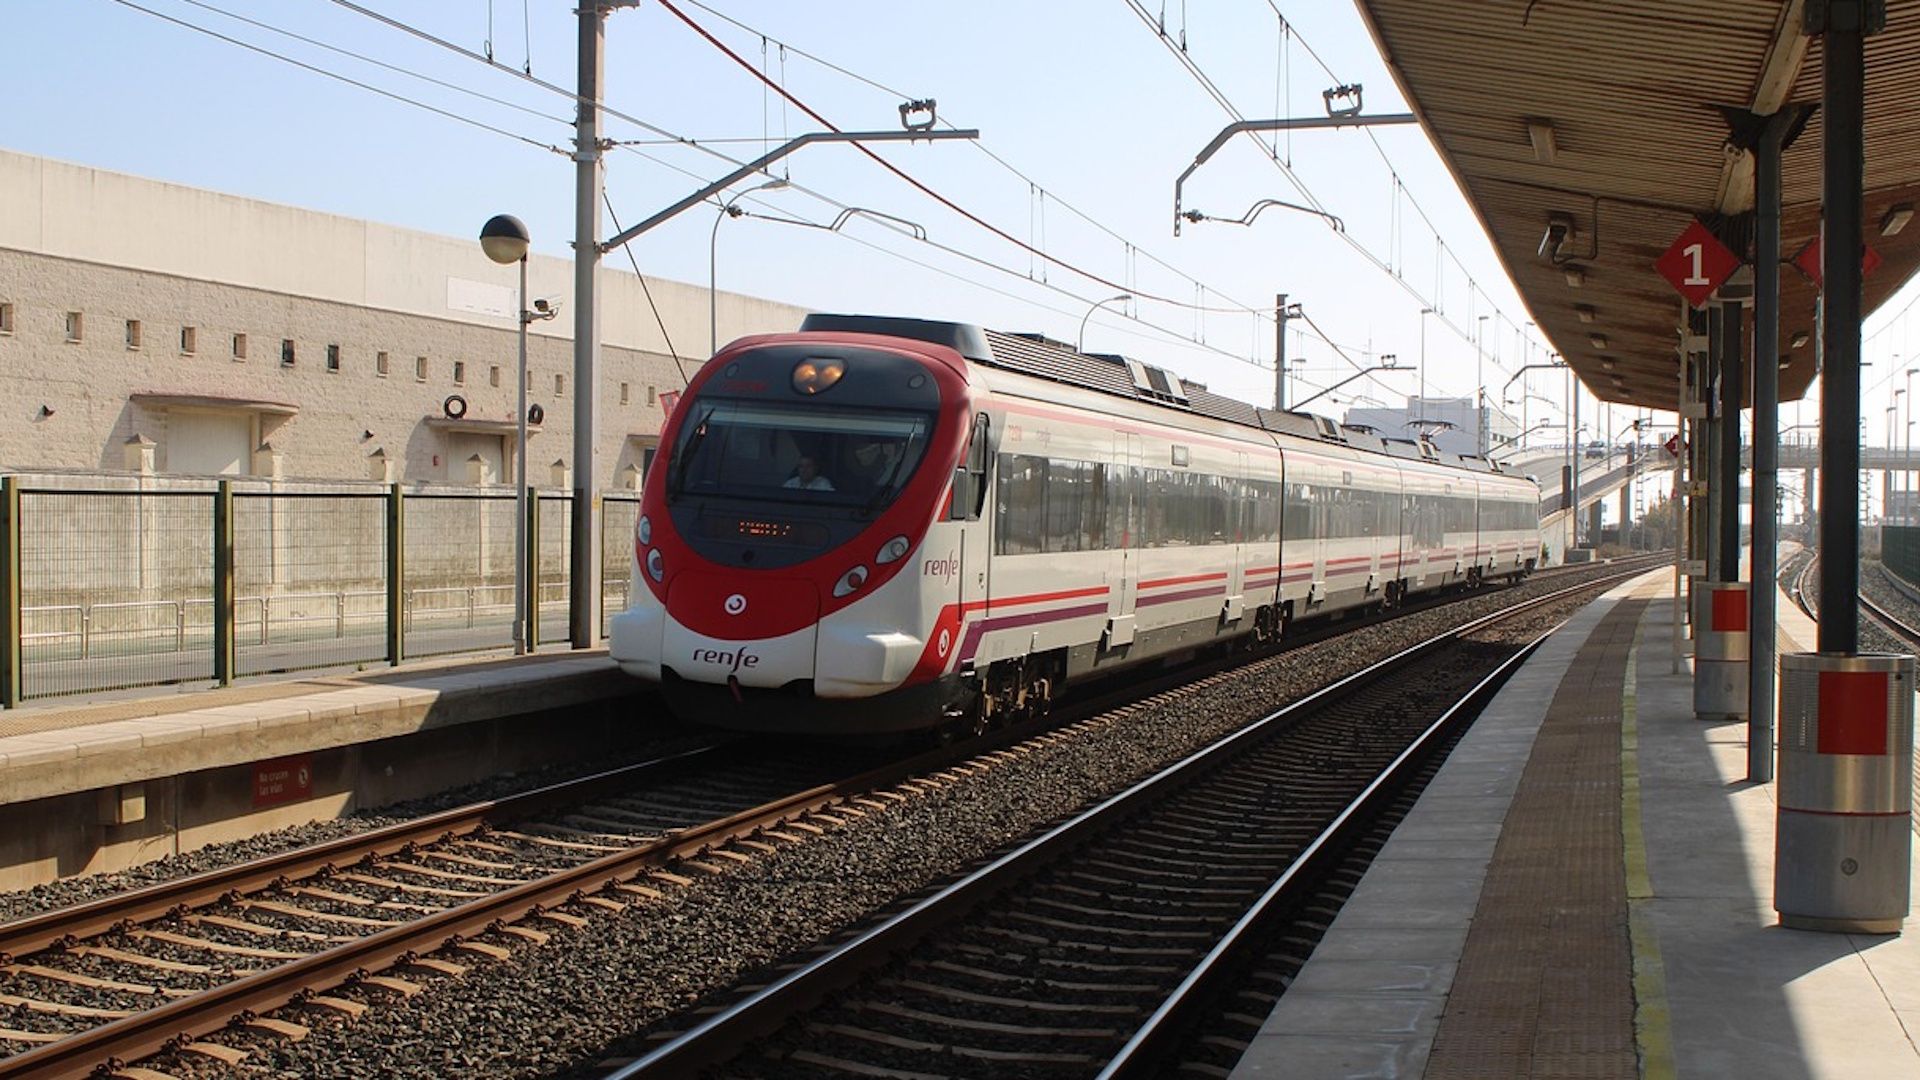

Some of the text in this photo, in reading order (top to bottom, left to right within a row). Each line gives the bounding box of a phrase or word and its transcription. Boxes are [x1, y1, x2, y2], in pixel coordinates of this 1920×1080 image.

[1682, 243, 1711, 286] 1
[923, 549, 959, 586] renfe
[692, 645, 760, 674] renfe
